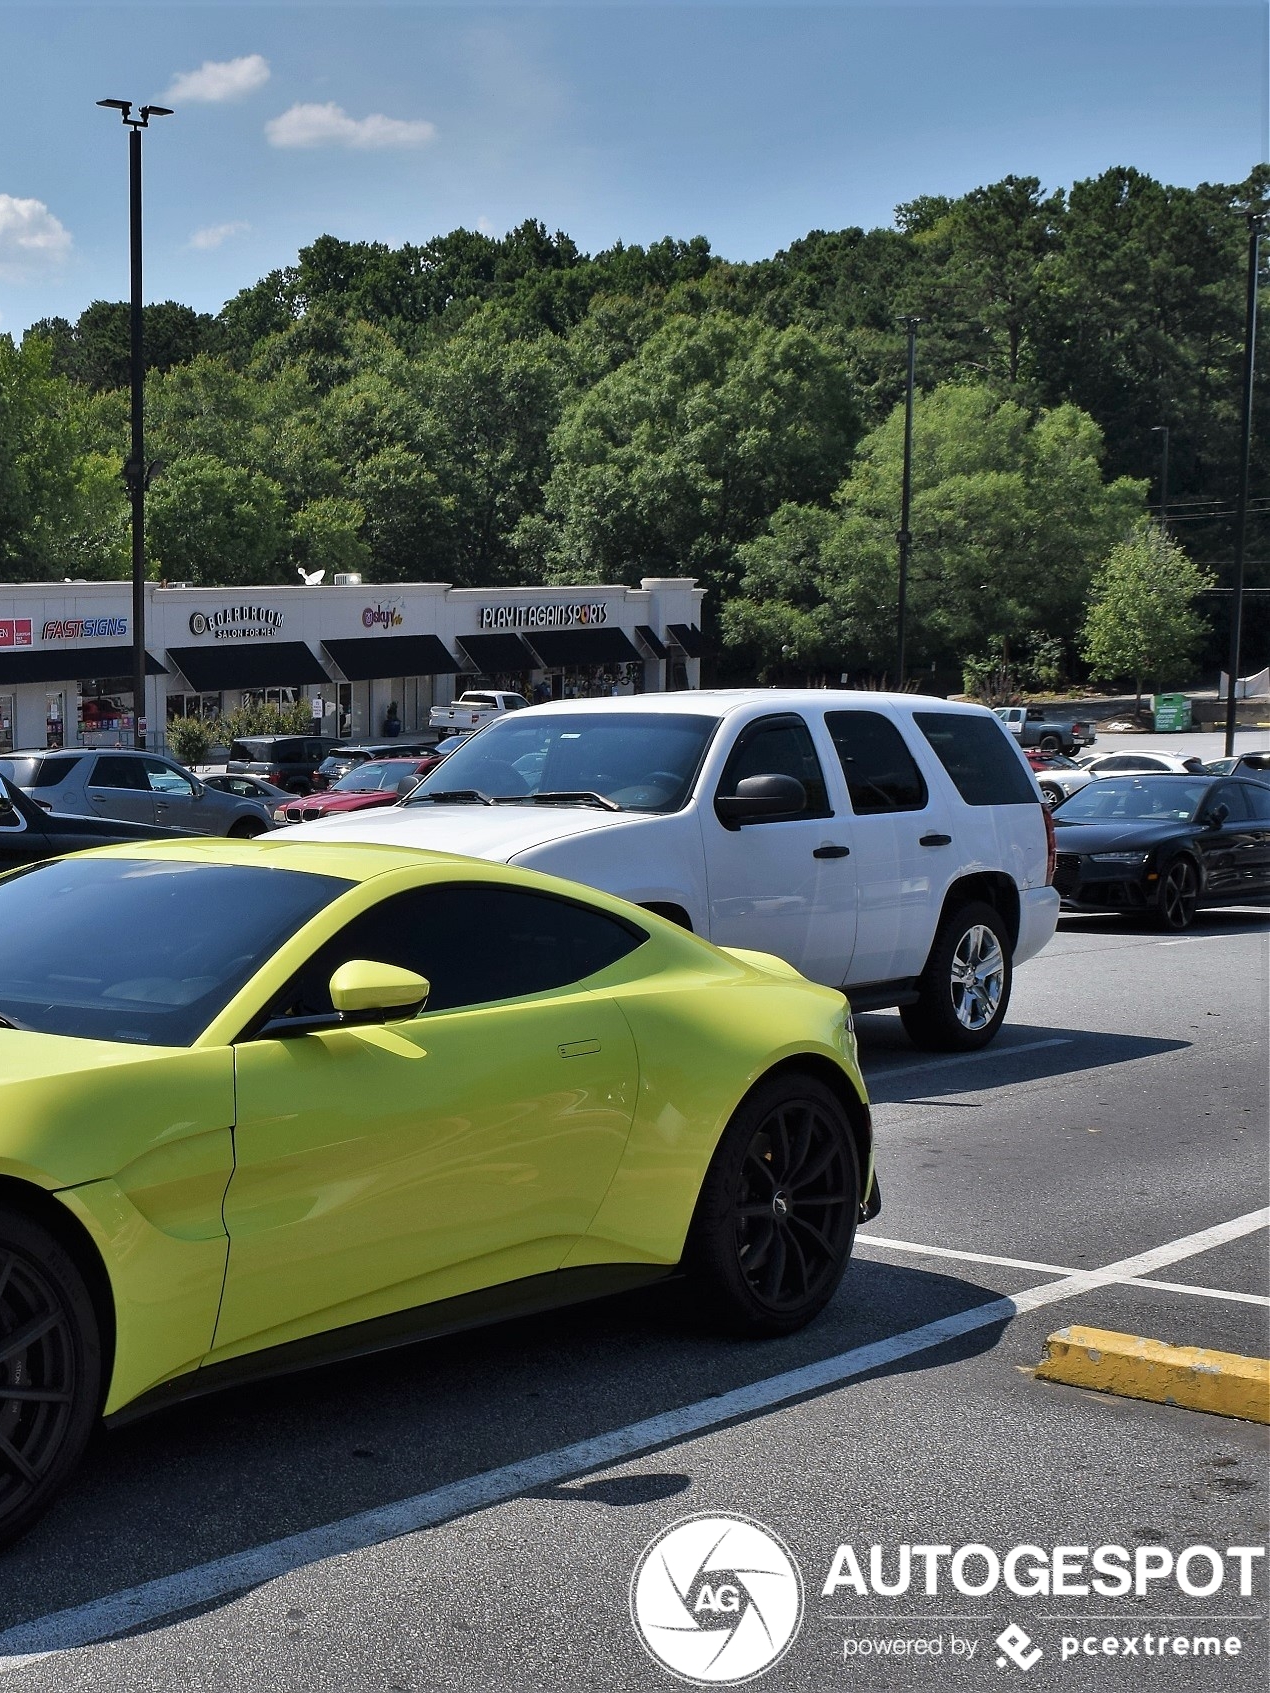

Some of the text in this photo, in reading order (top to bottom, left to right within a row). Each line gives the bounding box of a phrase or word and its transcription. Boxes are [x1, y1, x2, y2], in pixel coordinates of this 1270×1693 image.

[207, 606, 284, 631] BOARDROOM
[481, 602, 608, 628] PLAY IT AGAIN SPORTS
[42, 618, 128, 640] FASTSIGNS
[217, 627, 277, 639] SALON FOR MEN
